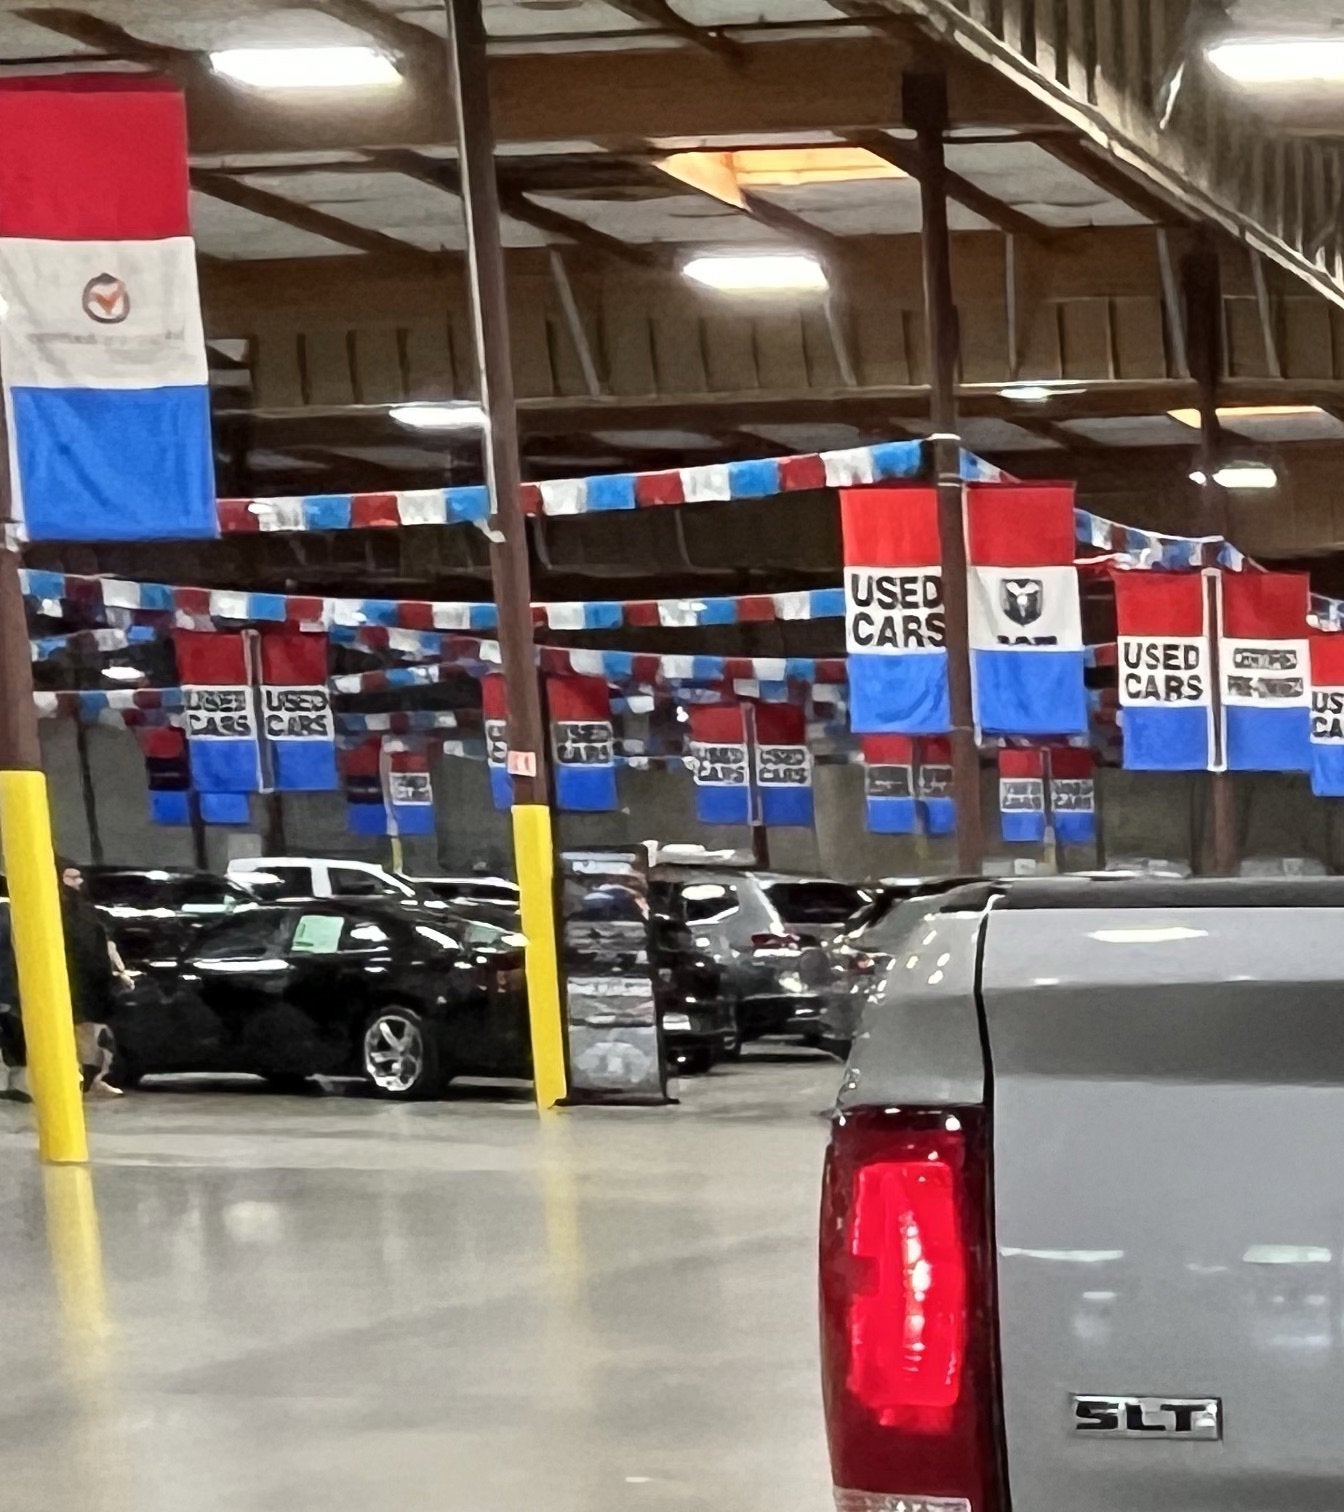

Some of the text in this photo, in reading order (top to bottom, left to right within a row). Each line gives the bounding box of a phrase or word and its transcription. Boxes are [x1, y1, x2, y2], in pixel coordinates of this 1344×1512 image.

[851, 573, 942, 610] USED
[852, 612, 945, 648] CARS
[1123, 642, 1200, 671] USED
[266, 690, 329, 712] USED
[1125, 673, 1203, 701] CARS
[266, 714, 328, 736] CARS
[1073, 1399, 1211, 1434] SLT
